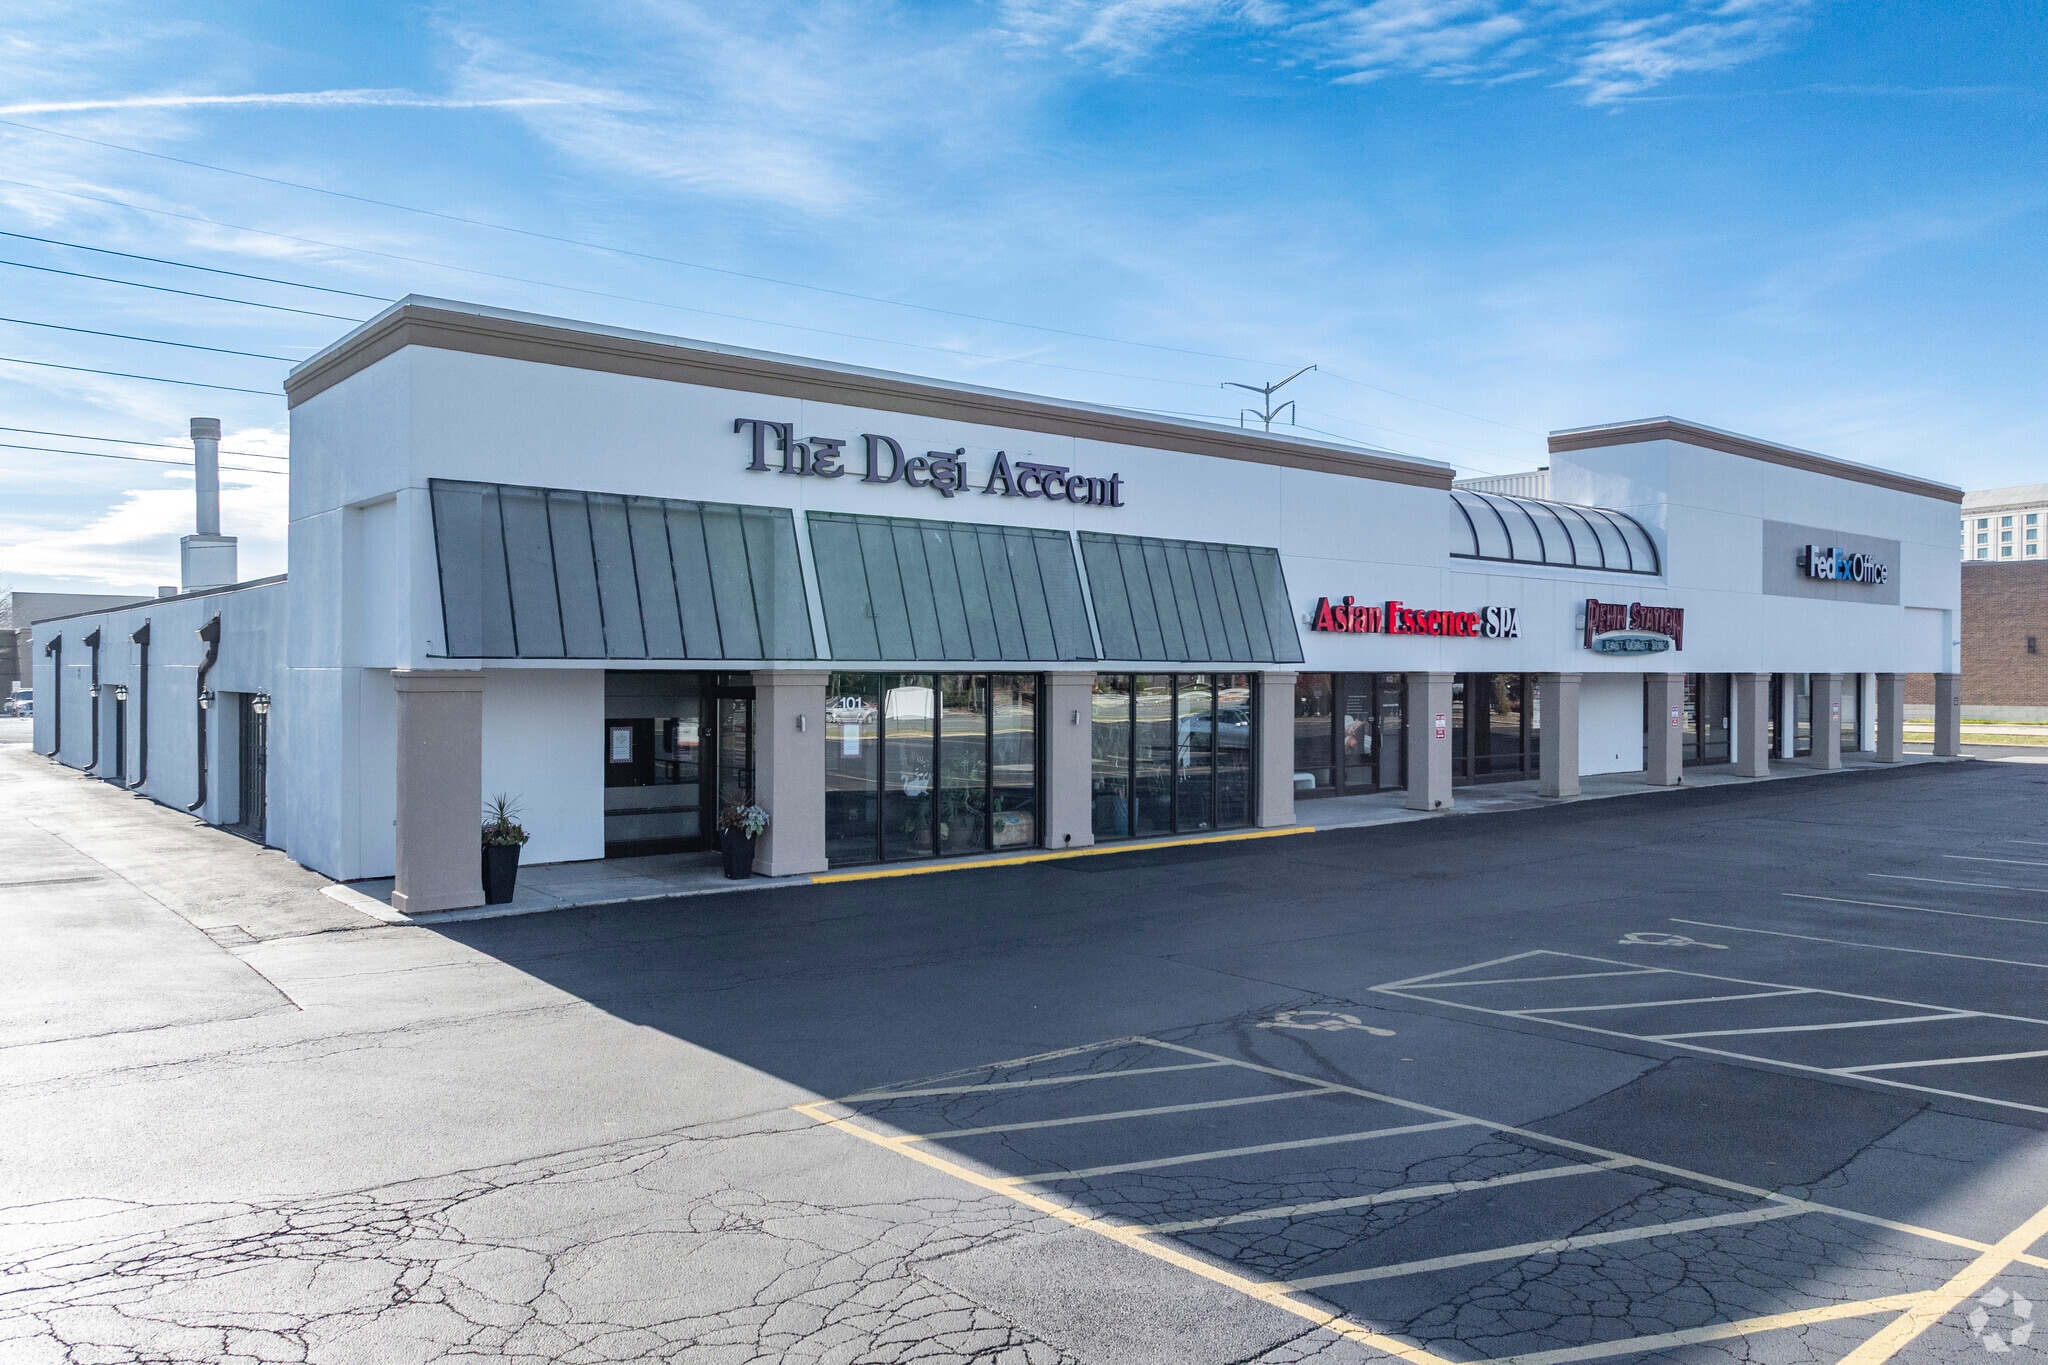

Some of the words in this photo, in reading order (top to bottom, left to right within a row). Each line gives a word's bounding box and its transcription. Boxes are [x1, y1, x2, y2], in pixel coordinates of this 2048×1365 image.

[734, 417, 846, 478] The
[860, 433, 970, 498] Desi
[982, 450, 1125, 508] Accent
[1805, 544, 1853, 580] FedEx
[1853, 552, 1888, 585] Office
[1311, 595, 1382, 634] Asian
[1385, 600, 1480, 637] Essence
[1481, 606, 1522, 639] SPA
[840, 696, 862, 710] 101
